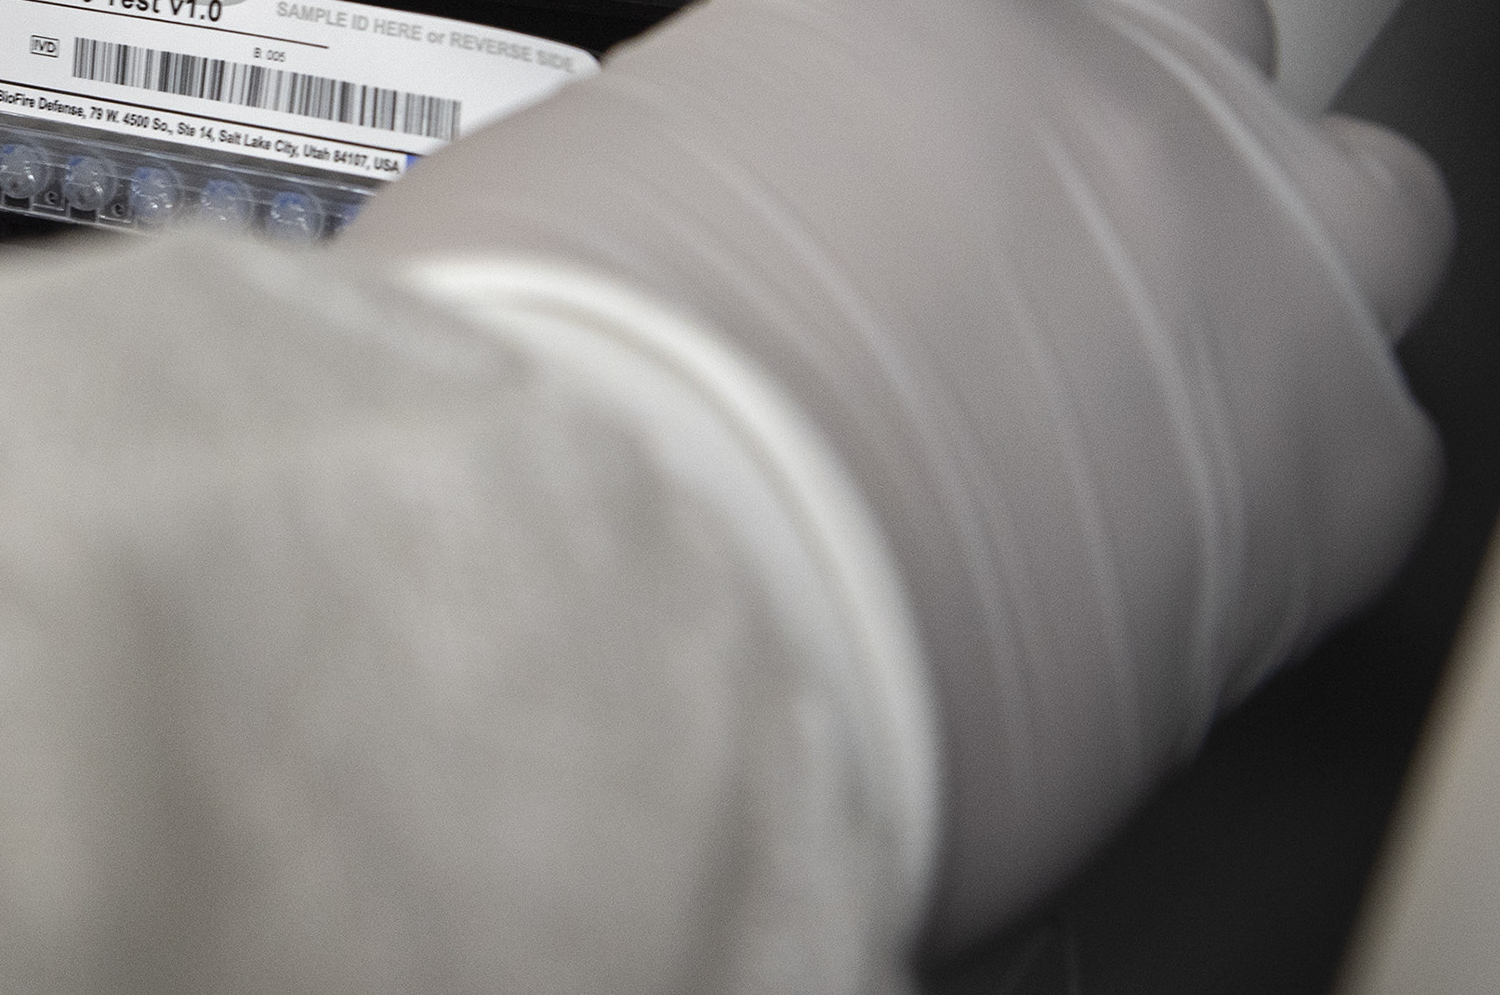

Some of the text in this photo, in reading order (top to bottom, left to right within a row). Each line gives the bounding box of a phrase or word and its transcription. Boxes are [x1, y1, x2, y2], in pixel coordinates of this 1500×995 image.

[276, 1, 348, 28] SAMPLE
[351, 14, 370, 32] ID
[373, 20, 423, 41] HERE
[426, 30, 445, 44] or
[449, 31, 533, 62] REVERSE
[38, 97, 87, 119] Defense,
[90, 106, 103, 120] 79
[106, 109, 120, 124] W.
[123, 112, 150, 129] 4500
[177, 122, 196, 137] Ste
[199, 125, 216, 142] 14,
[219, 129, 242, 145] Salt
[243, 133, 272, 151] Lake
[303, 144, 330, 161] Utah
[373, 157, 399, 173] USA
